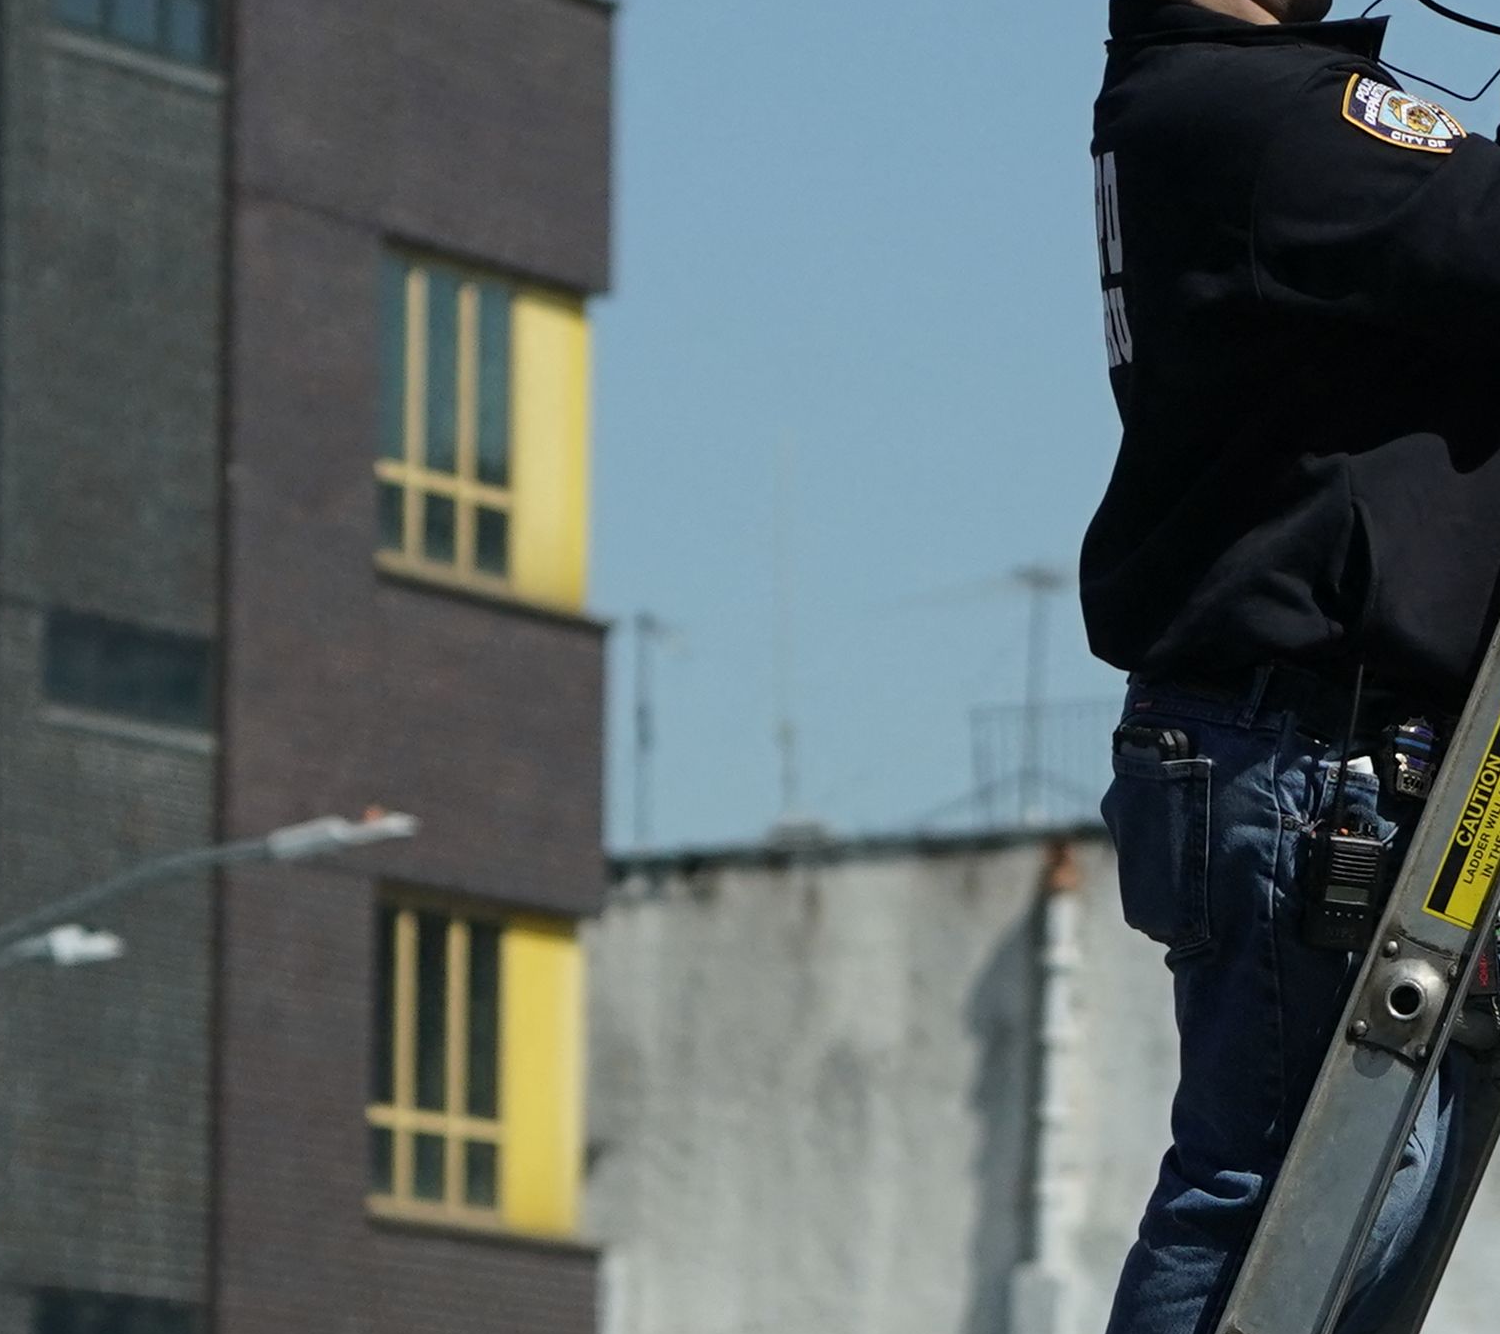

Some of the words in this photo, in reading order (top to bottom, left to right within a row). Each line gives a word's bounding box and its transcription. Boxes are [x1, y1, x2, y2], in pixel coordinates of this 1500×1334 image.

[1390, 130, 1425, 146] CITY
[1427, 139, 1448, 148] OF
[1463, 832, 1491, 884] LADDER
[1481, 863, 1495, 878] IN
